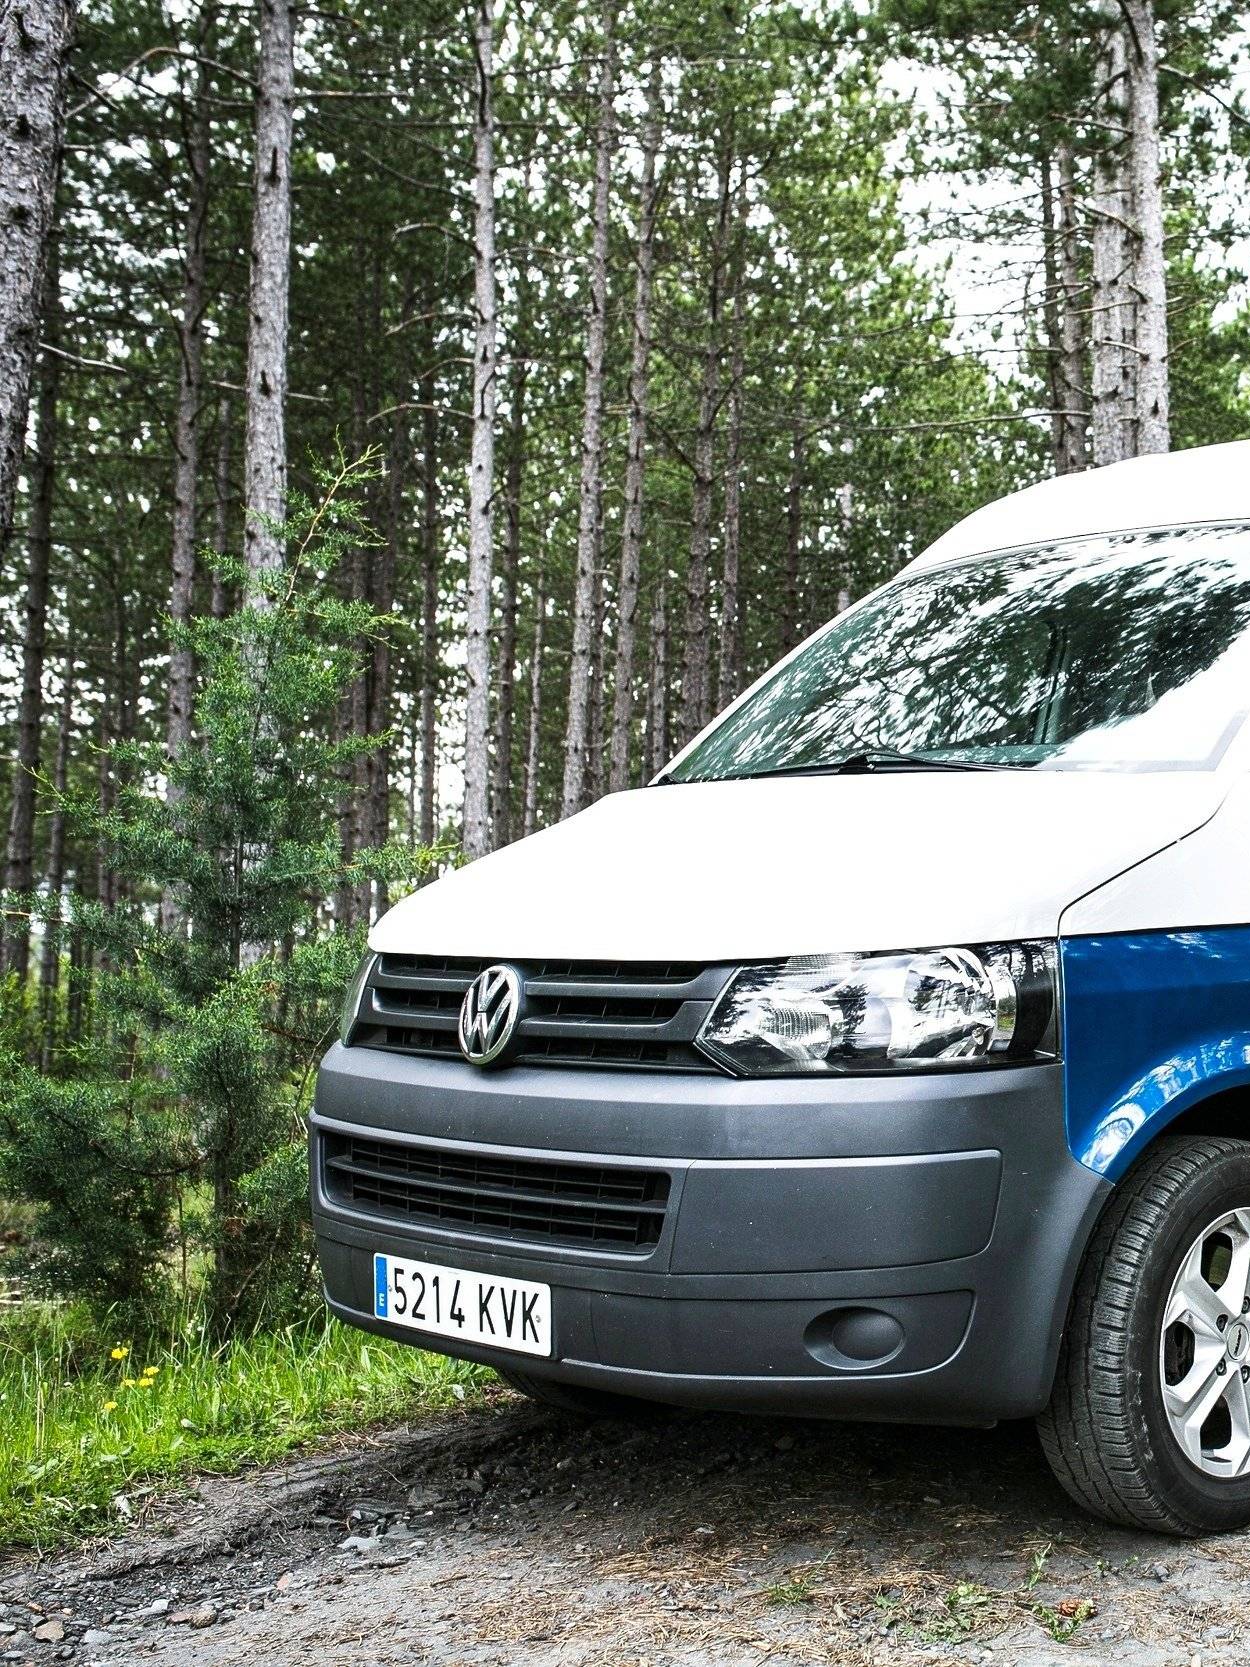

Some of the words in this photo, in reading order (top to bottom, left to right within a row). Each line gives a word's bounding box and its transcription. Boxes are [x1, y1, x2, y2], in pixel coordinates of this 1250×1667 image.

[462, 967, 514, 1058] VW
[378, 1293, 385, 1307] E
[393, 1267, 465, 1328] 5214
[478, 1283, 540, 1343] KVK
